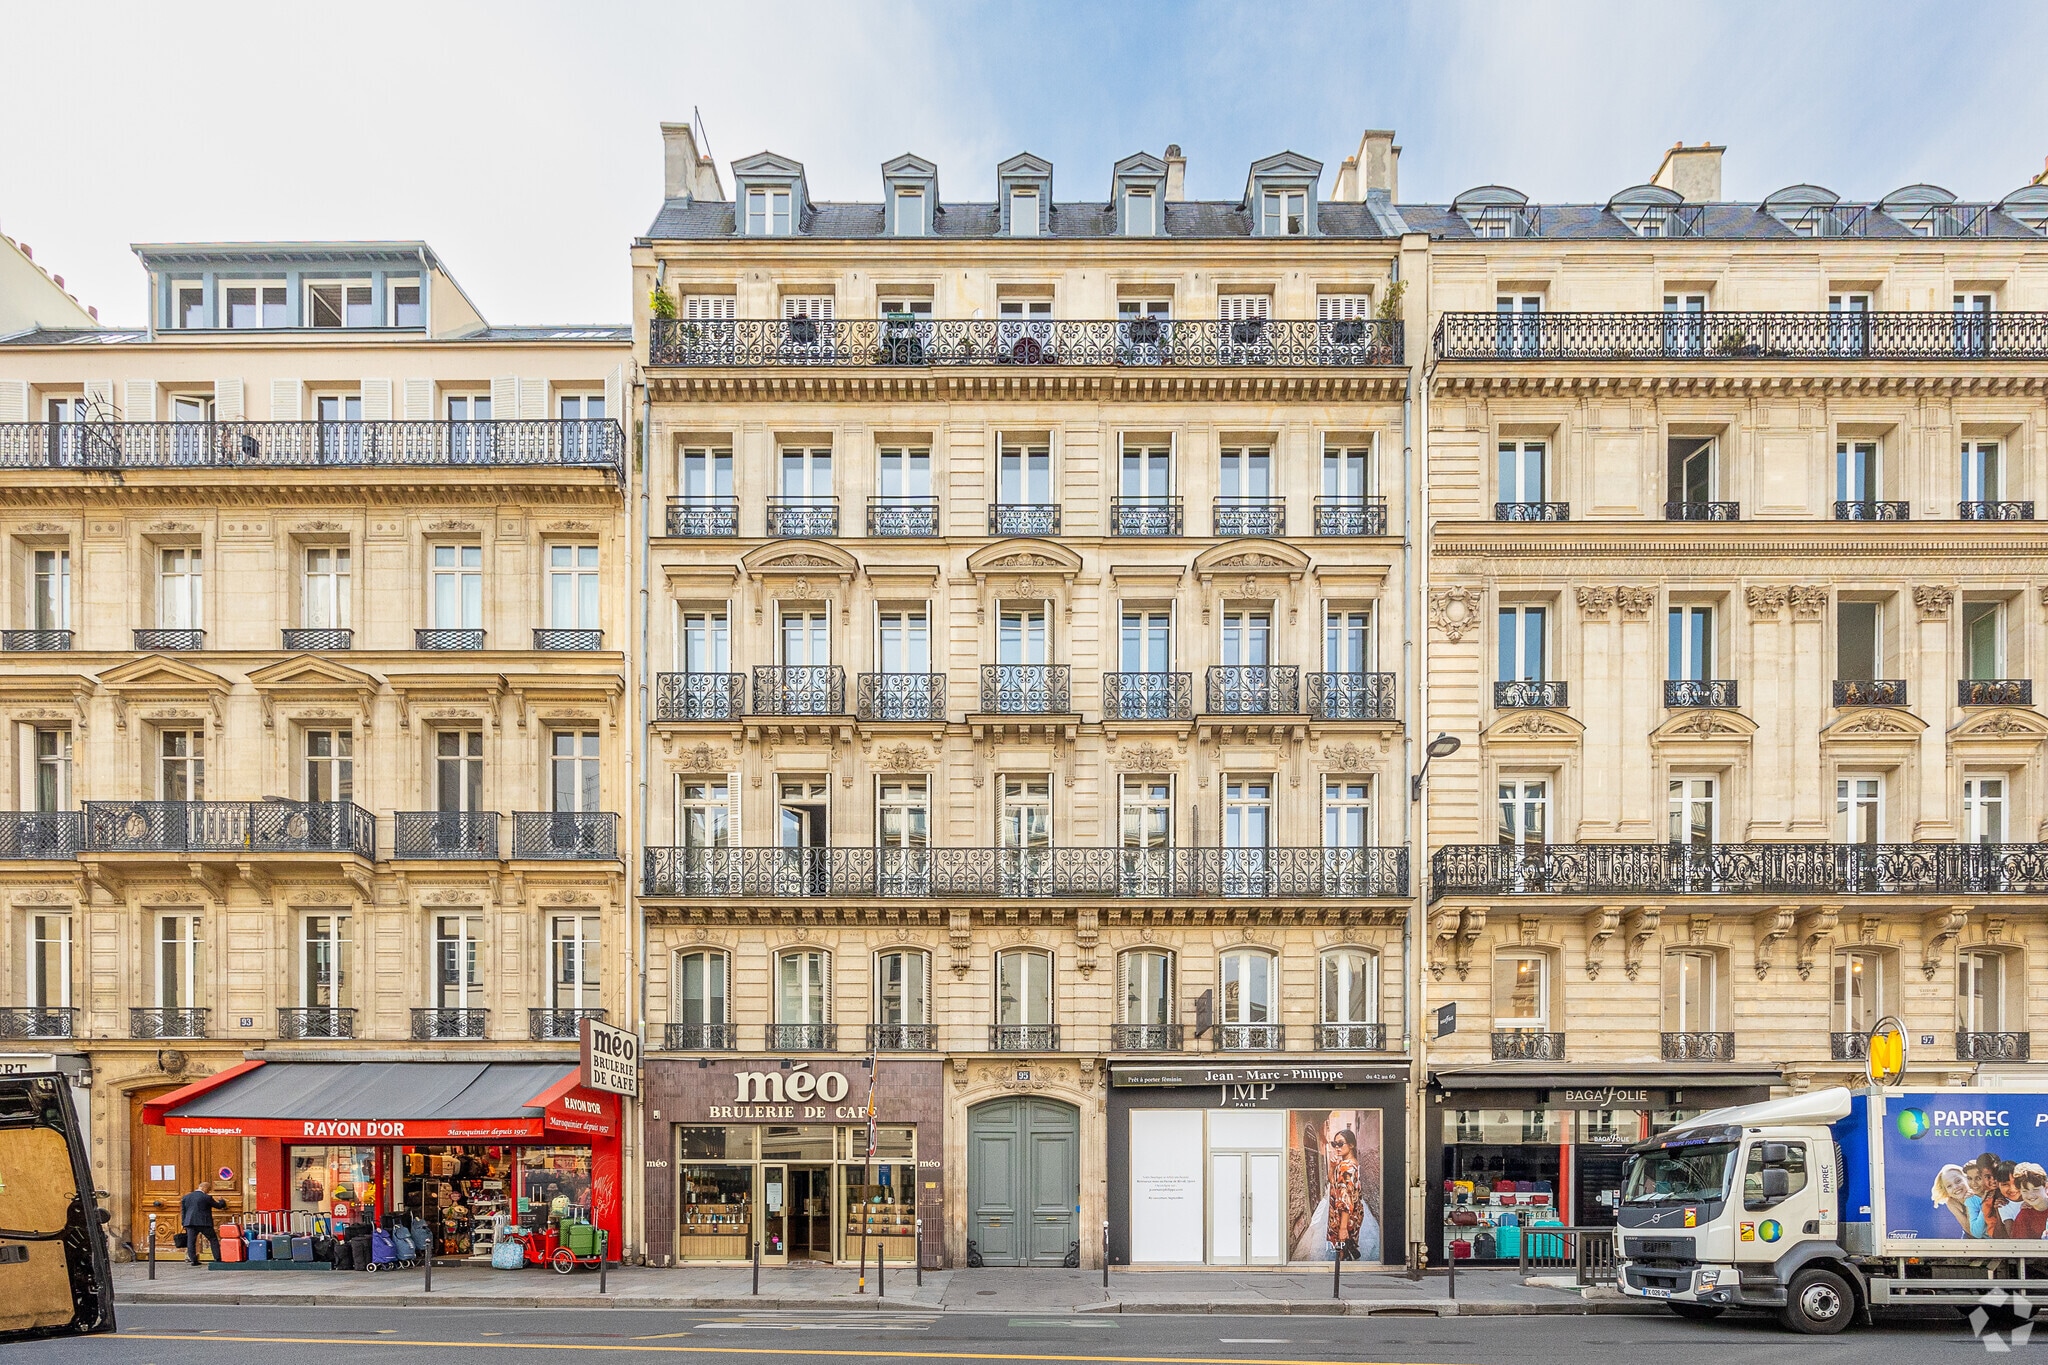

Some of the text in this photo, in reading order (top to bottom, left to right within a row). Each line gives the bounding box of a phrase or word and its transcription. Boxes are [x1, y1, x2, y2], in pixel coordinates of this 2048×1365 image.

[241, 1018, 251, 1026] 93
[593, 1029, 634, 1061] méo
[1922, 1035, 1933, 1044] 97
[1870, 1030, 1902, 1079] M
[0, 1063, 27, 1074] RT
[593, 1054, 634, 1077] BRULERIE
[594, 1069, 634, 1092] DE CAFE
[734, 1062, 849, 1102] méo
[1018, 1071, 1029, 1080] 95
[1204, 1071, 1234, 1081] Jean
[1246, 1070, 1280, 1080] Marc
[1291, 1069, 1344, 1081] Philippe
[1220, 1084, 1276, 1107] JMP
[564, 1097, 601, 1114] RAYON D'OR
[709, 1106, 794, 1118] BRULERIE
[804, 1106, 826, 1118] DE
[550, 1117, 609, 1134] Maroquinier depuis 1957
[1934, 1110, 2010, 1127] PAPREC
[180, 1127, 242, 1135] rayondor-bagages.fr
[303, 1121, 405, 1137] RAYON D'OR
[447, 1127, 490, 1136] Maroquinier
[491, 1127, 513, 1138] depuis
[1935, 1128, 2010, 1137] RECYCLAGE
[646, 1158, 668, 1168] méo
[919, 1159, 941, 1168] méo
[1821, 1164, 1830, 1194] PAPREC
